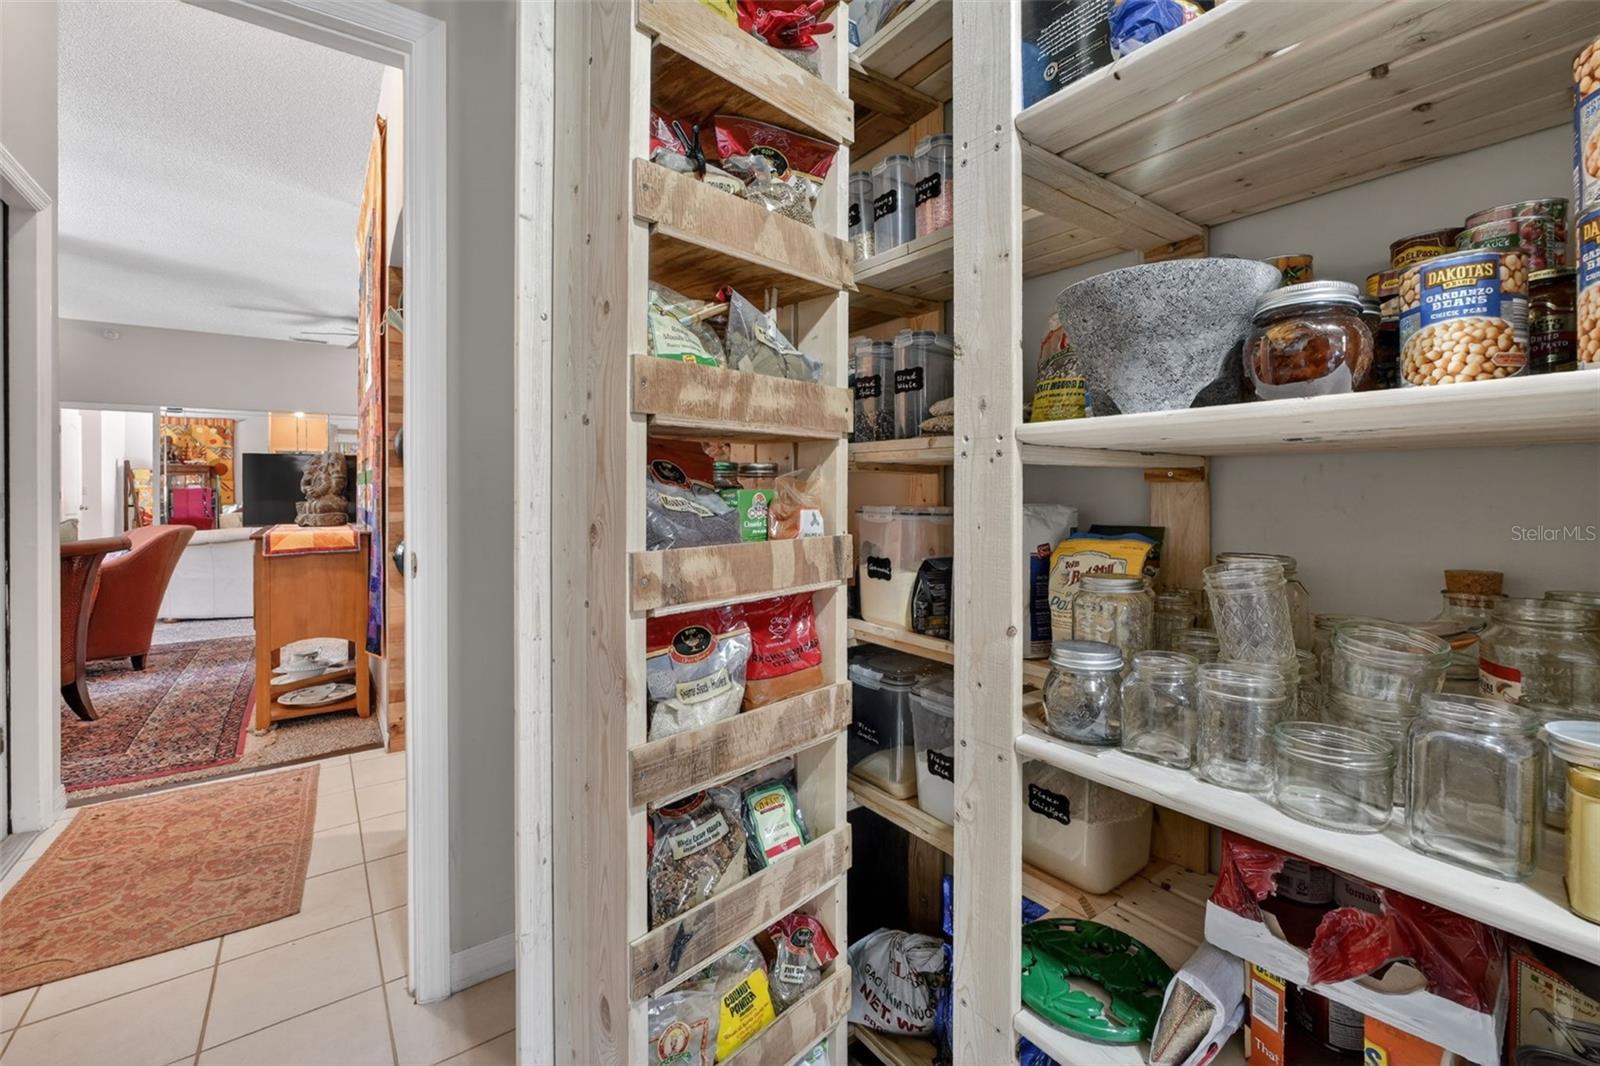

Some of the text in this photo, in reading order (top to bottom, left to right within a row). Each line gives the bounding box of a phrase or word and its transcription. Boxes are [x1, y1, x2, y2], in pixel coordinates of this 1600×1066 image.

[1428, 263, 1494, 286] DAKOTA'S
[1426, 287, 1494, 304] GARBANZO
[1432, 295, 1488, 311] BEANS
